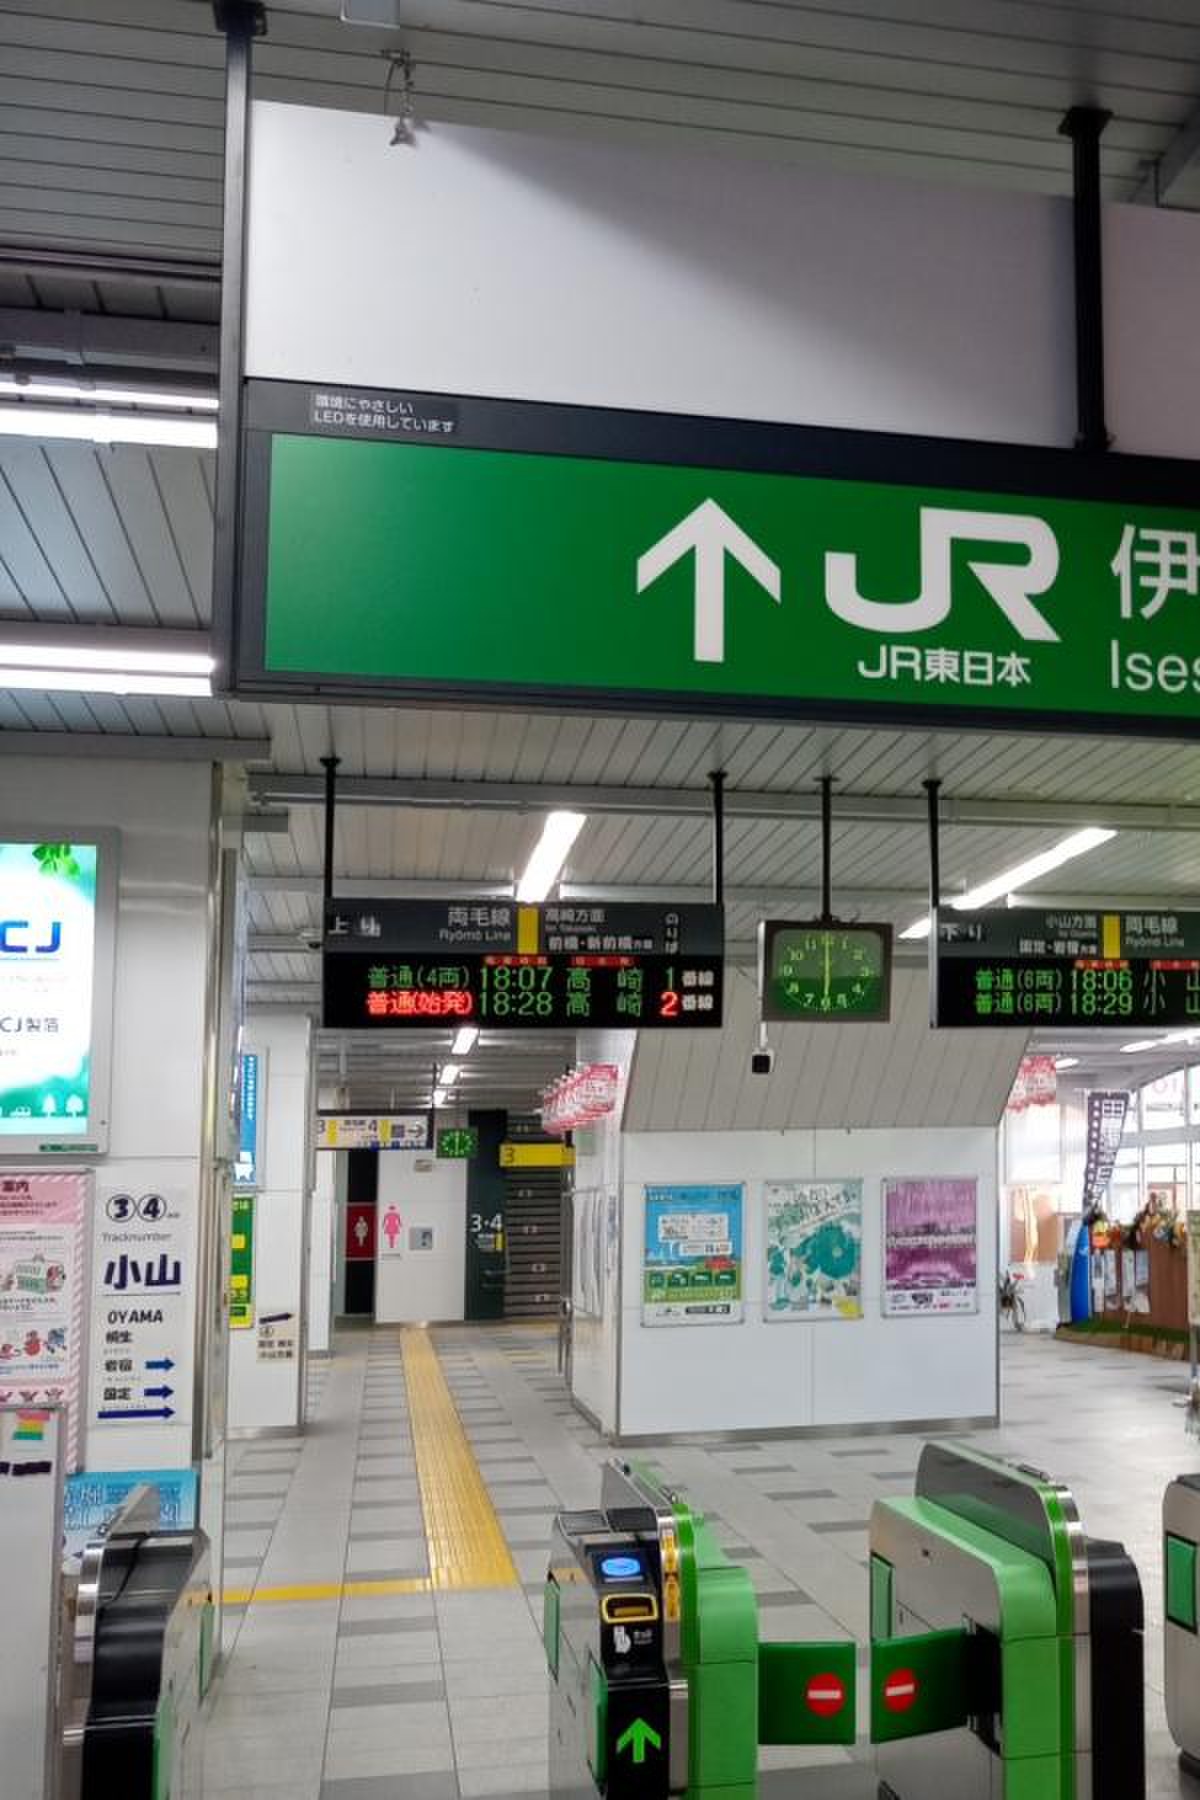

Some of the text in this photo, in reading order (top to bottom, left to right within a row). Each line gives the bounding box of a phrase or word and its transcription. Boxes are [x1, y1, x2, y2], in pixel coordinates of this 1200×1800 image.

[825, 505, 1061, 643] JR
[857, 645, 1032, 688] JR東日本
[480, 966, 554, 991] 18:07
[480, 991, 554, 1017] 18:28
[660, 991, 679, 1017] 2
[1071, 993, 1133, 1016] 18:29
[103, 1252, 181, 1290] 小山
[107, 1308, 163, 1325] OYAMA
